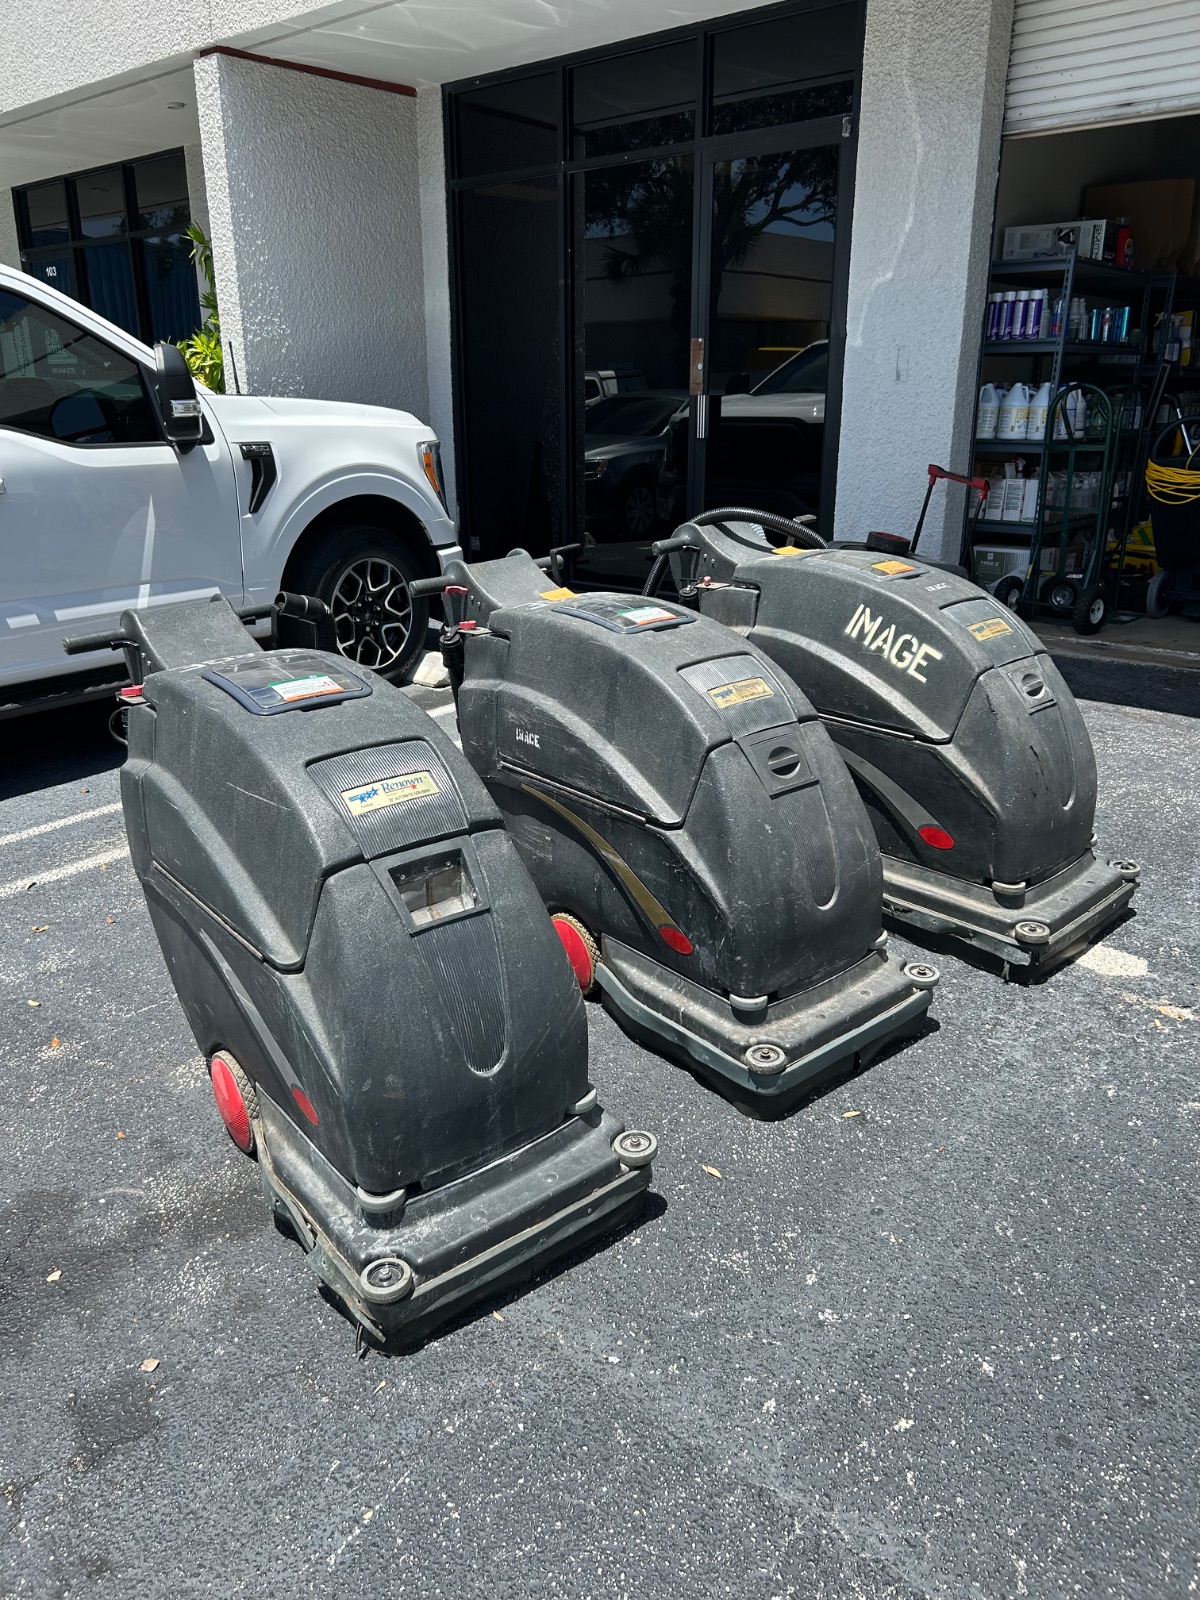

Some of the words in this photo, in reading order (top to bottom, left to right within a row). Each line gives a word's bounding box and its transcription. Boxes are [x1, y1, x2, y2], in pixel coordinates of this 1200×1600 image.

[45, 266, 57, 277] 103
[844, 603, 943, 684] IMAGE
[380, 776, 423, 793] Renown
